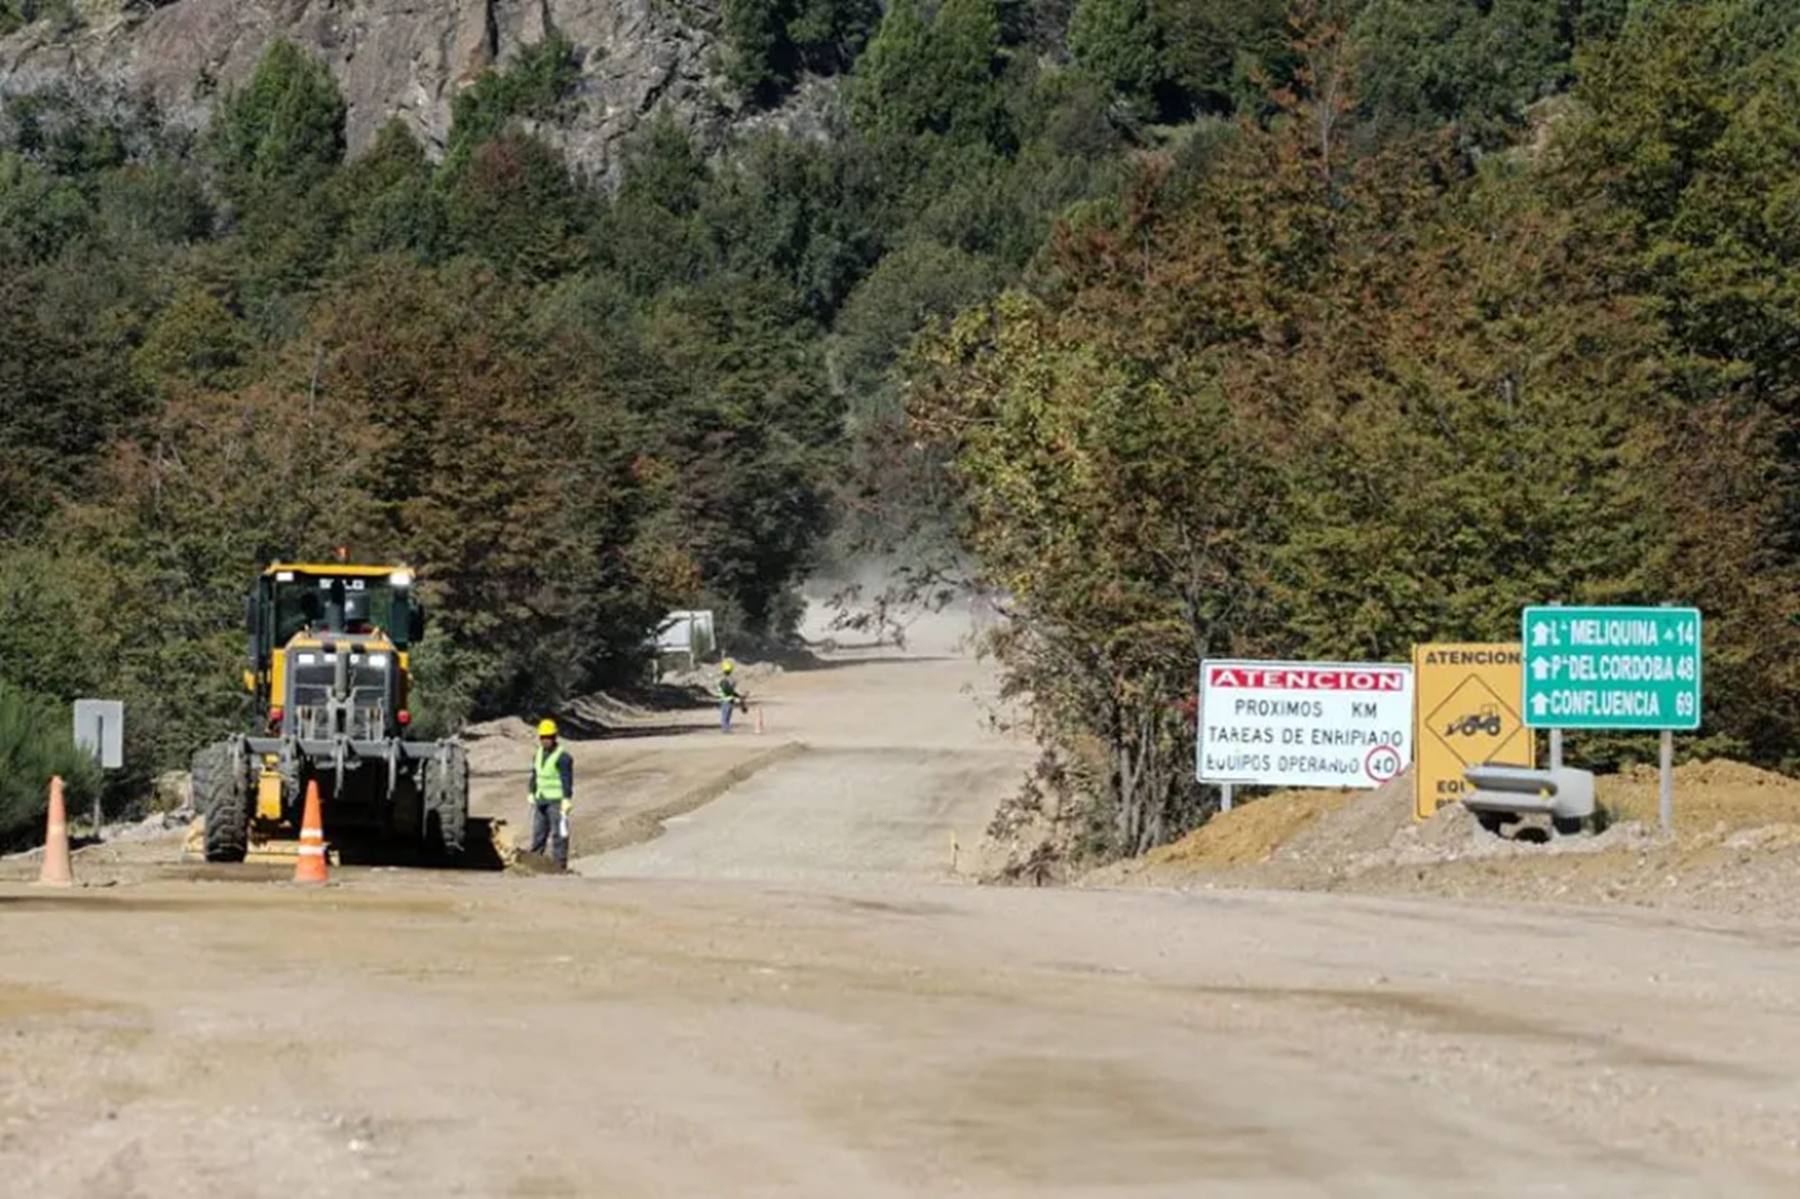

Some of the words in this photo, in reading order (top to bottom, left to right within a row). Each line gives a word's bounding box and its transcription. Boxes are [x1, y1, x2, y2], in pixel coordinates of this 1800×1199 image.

[1570, 619, 1658, 646] MELIQUINA
[1676, 621, 1694, 646] 14
[1425, 651, 1520, 665] ATENCION
[1569, 655, 1598, 681] DEL
[1599, 655, 1674, 681] CORDOBA
[1213, 671, 1401, 690] ATENCION
[1235, 699, 1323, 717] PROXIMOS
[1351, 702, 1377, 718] KM
[1551, 690, 1659, 716] CONFLUENCIA
[1676, 691, 1694, 716] 69
[1209, 726, 1274, 744] TAREAS
[1282, 729, 1304, 745] DE
[1311, 730, 1403, 747] ENRIPIADO
[1206, 754, 1271, 772] EQUIPOS
[1373, 757, 1395, 774] 40
